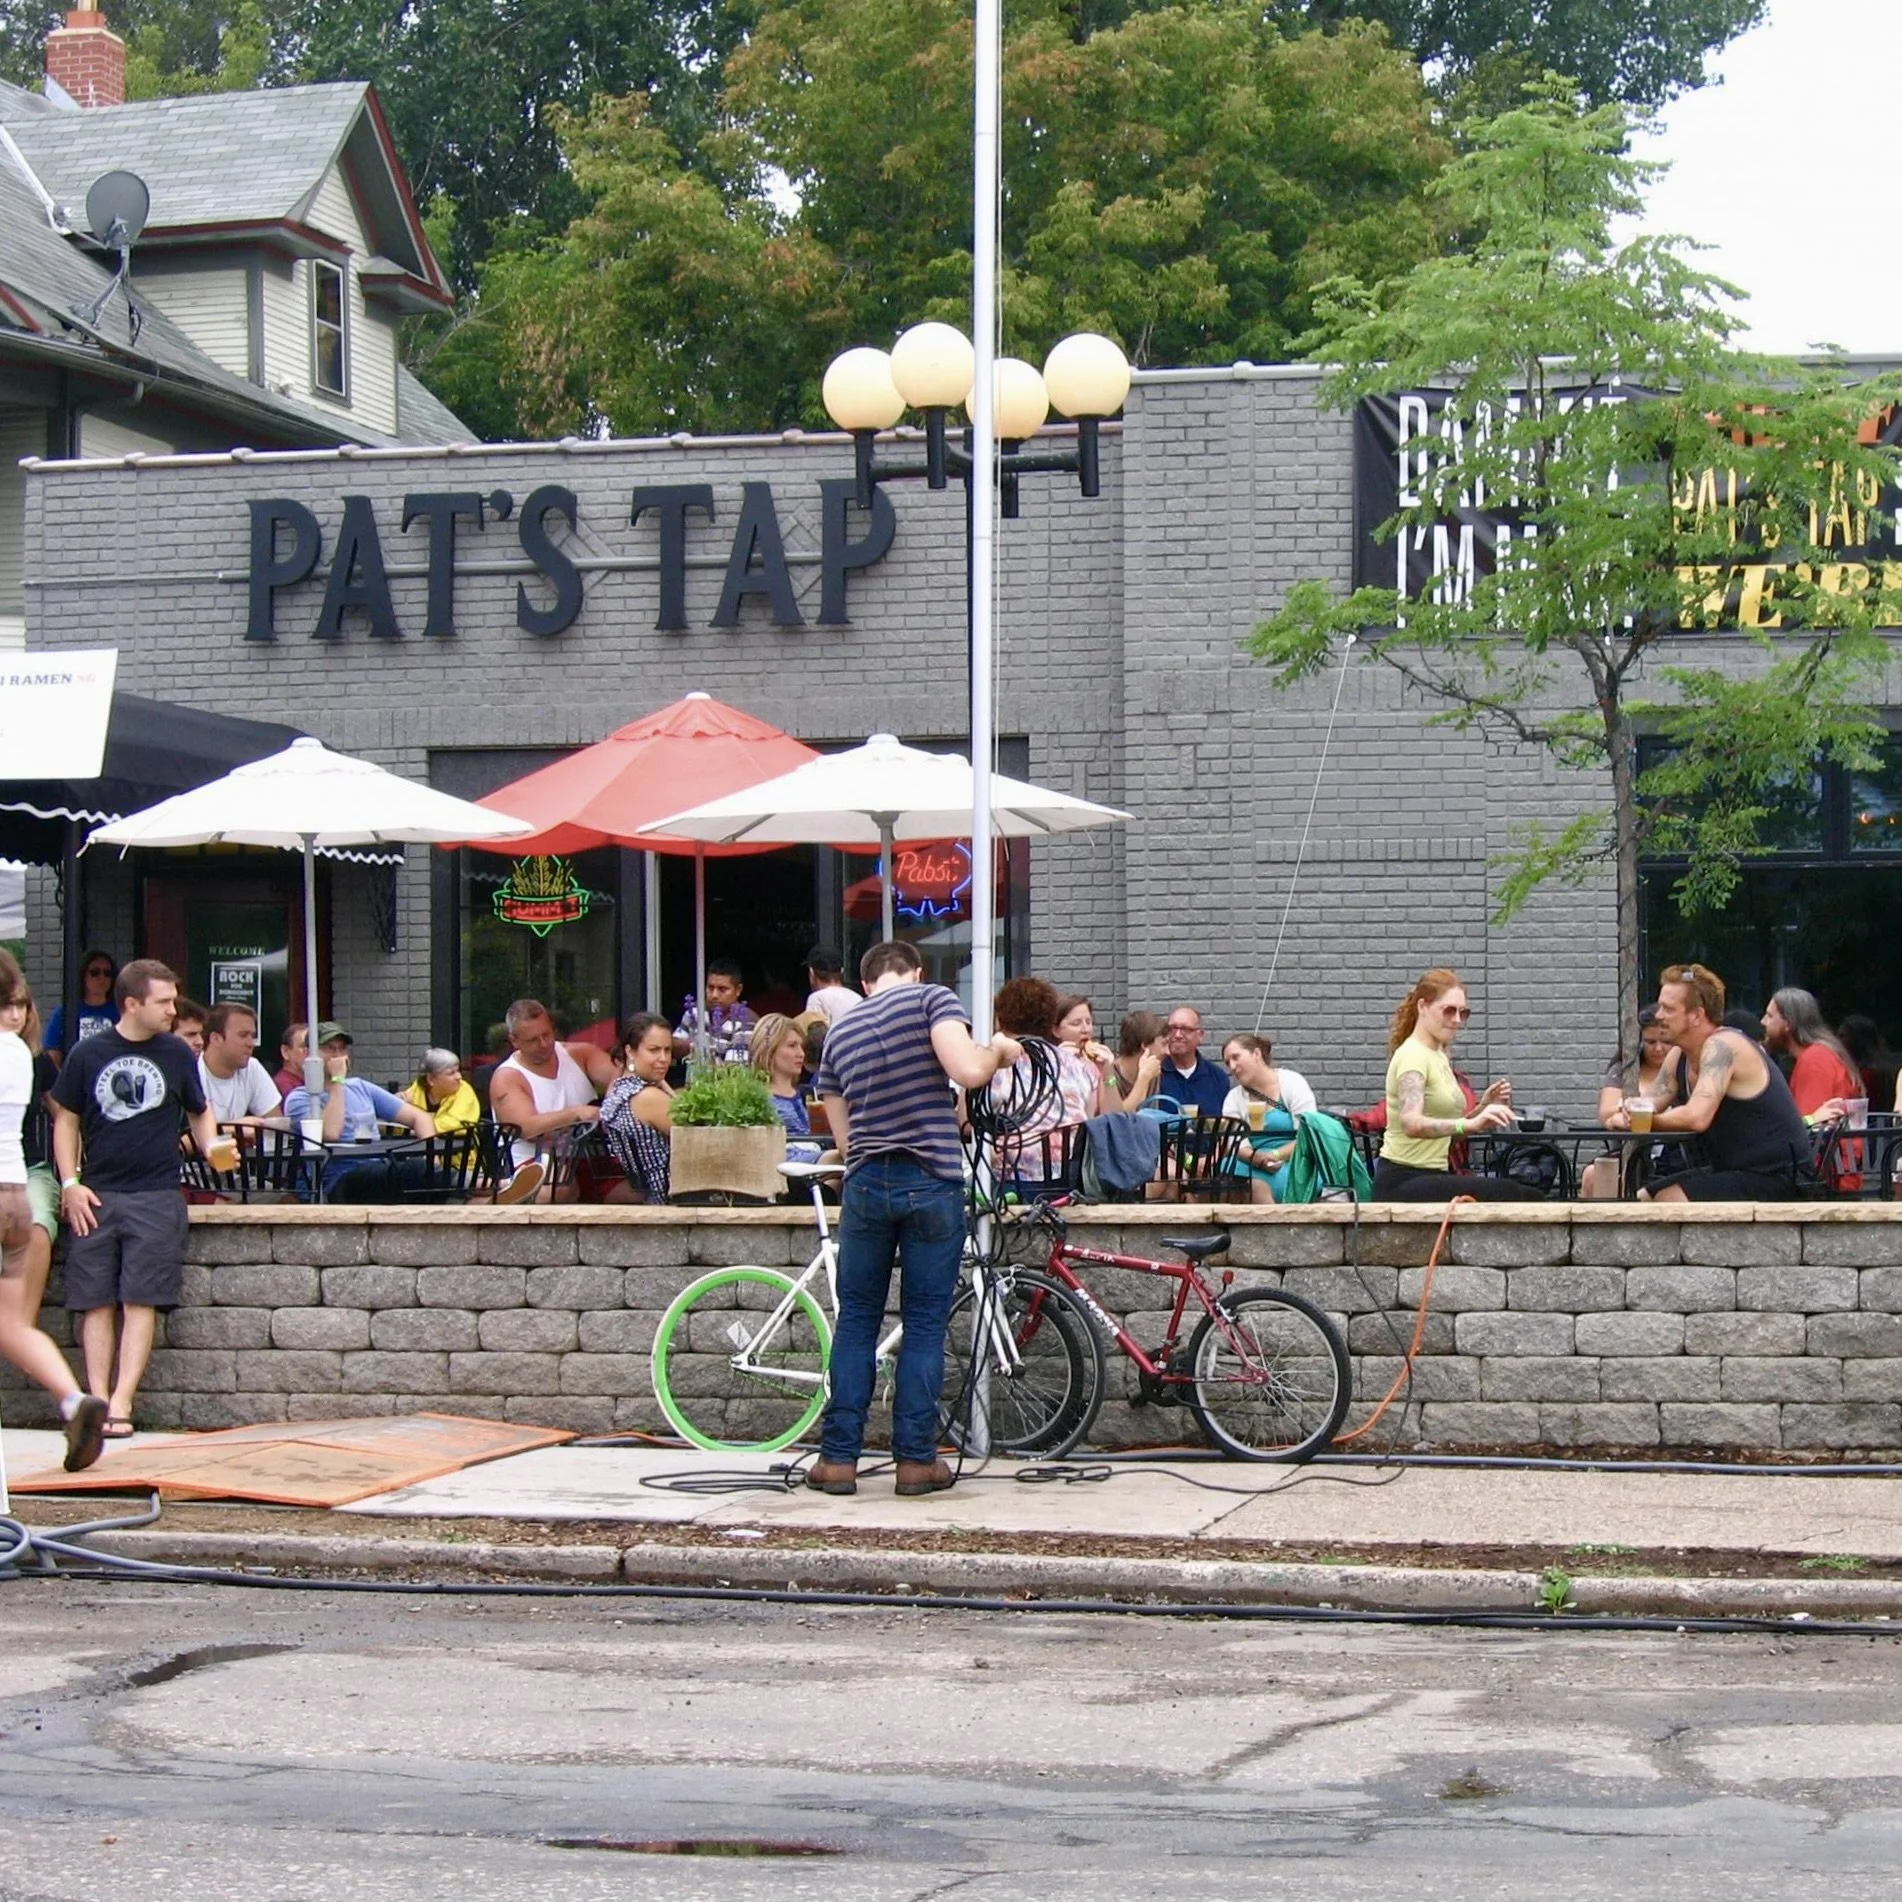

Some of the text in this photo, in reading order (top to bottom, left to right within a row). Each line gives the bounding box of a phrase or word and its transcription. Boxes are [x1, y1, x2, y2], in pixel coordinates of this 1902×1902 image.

[243, 479, 896, 639] PAT'S TAP
[10, 673, 72, 686] RAMEN
[896, 851, 960, 882] Pabst
[208, 946, 265, 956] WELCOME
[219, 971, 254, 983] ROCK
[116, 1059, 135, 1069] TOE
